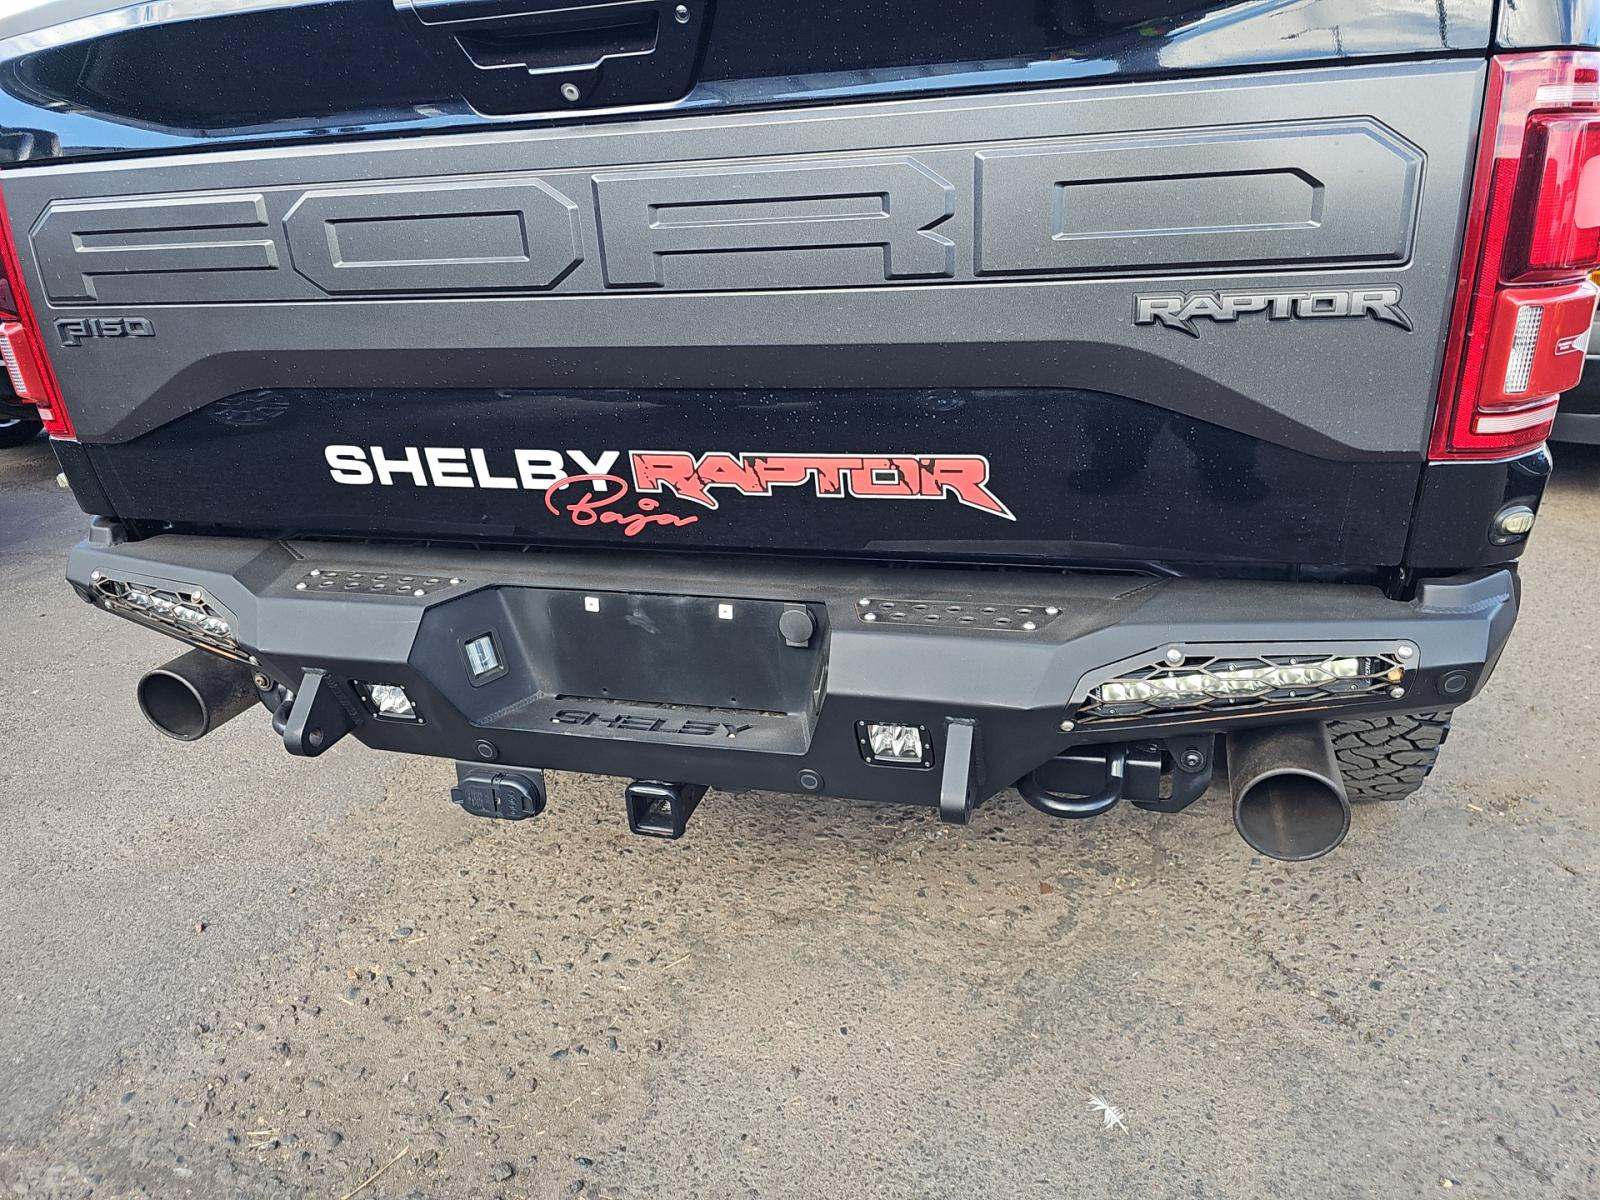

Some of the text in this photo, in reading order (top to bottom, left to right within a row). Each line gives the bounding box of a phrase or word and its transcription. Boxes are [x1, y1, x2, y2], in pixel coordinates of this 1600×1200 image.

[29, 114, 1427, 306] FORD
[1133, 283, 1414, 338] RAPTOR
[324, 444, 1017, 522] SHELBY RAPTOR
[550, 709, 754, 738] SHELBY
